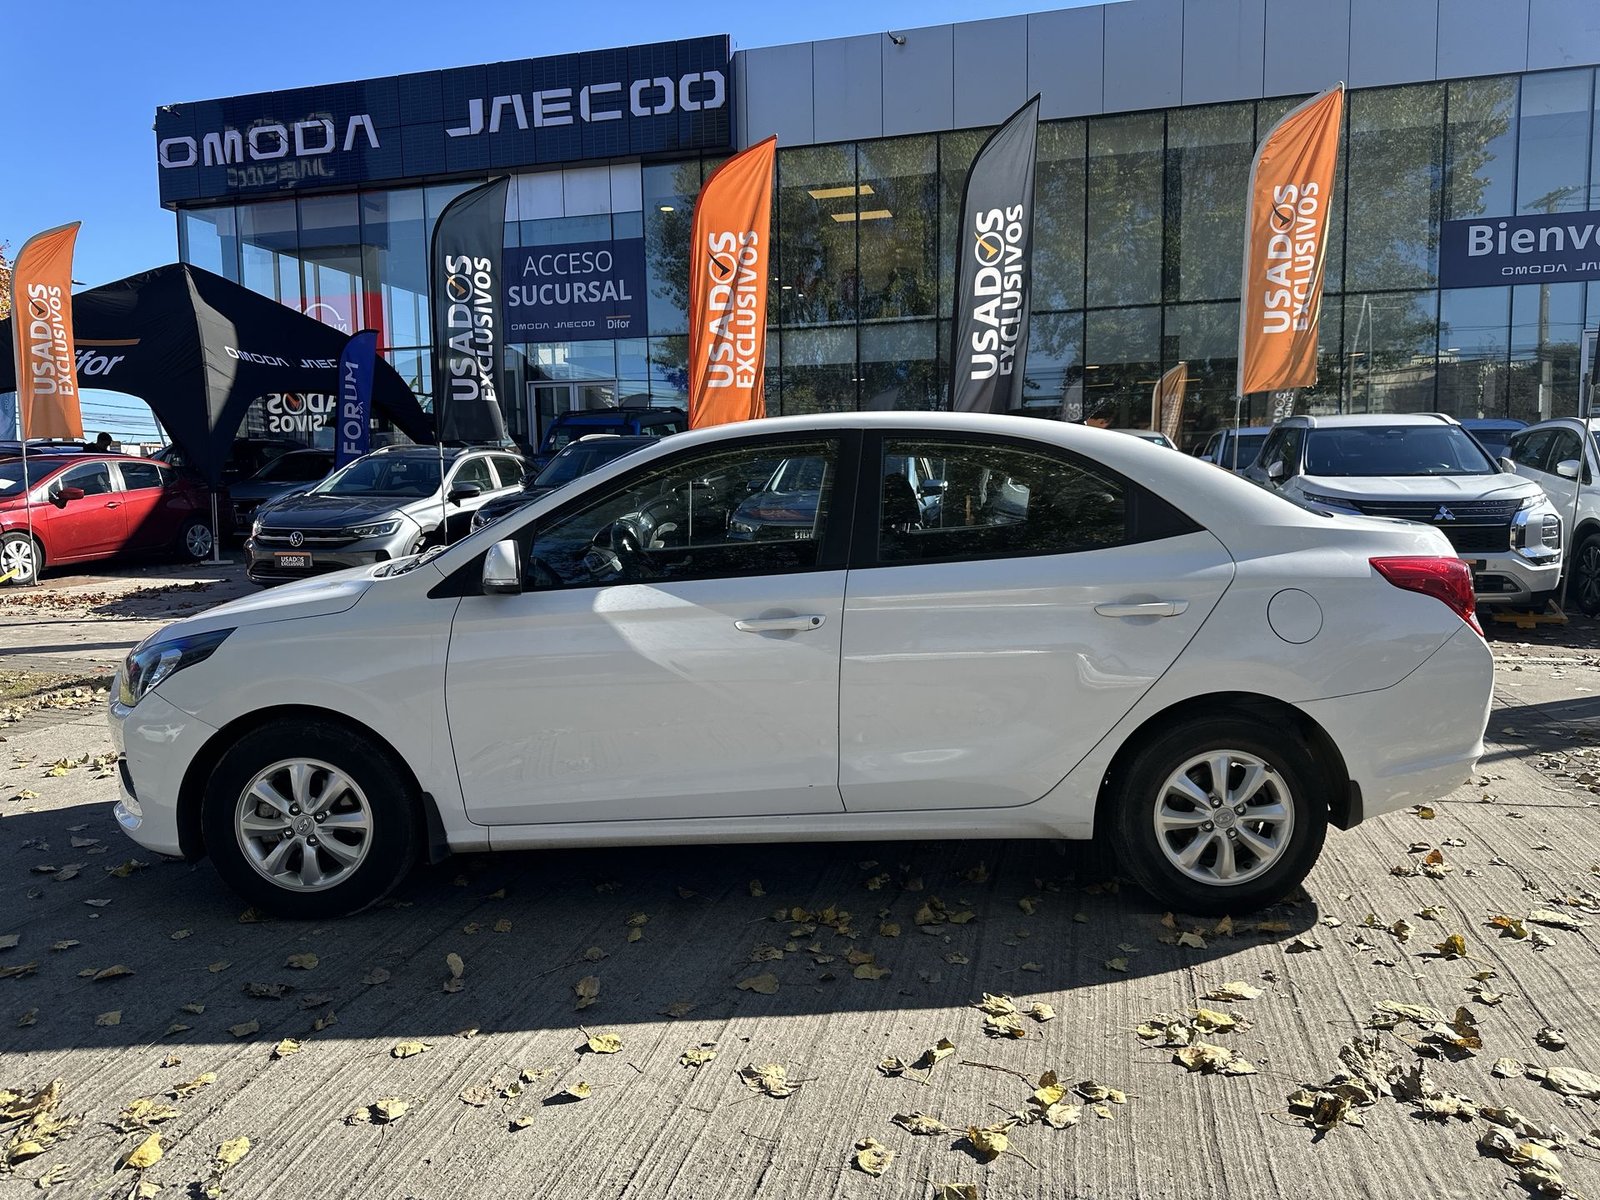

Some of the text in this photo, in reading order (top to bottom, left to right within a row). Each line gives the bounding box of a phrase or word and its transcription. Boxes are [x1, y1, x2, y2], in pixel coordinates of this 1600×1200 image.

[159, 114, 381, 169] OMODA
[445, 70, 726, 137] JAECOO
[522, 250, 613, 277] ACCESO
[1263, 184, 1298, 334] USADOS
[1292, 182, 1319, 331] EXCLUSIVOS
[1468, 221, 1600, 257] Bienv
[1501, 261, 1600, 276] OMODA JA
[445, 255, 479, 401] USADOS
[473, 256, 497, 401] EXCLUSIVOS
[508, 279, 633, 307] SUCURSAL
[511, 320, 596, 331] OMODA JAECOO
[607, 319, 631, 329] Difor
[708, 231, 738, 388] USADOS
[736, 230, 758, 389] EXCLUSIVOS
[970, 208, 1005, 380] USADOS
[1000, 203, 1024, 376] EXCLUSIVOS
[28, 283, 57, 395] USADOS
[48, 285, 75, 396] EXCLUSIVOS
[75, 349, 125, 376] ifor
[224, 345, 338, 369] OMODA JAEC
[343, 361, 363, 455] FORUM
